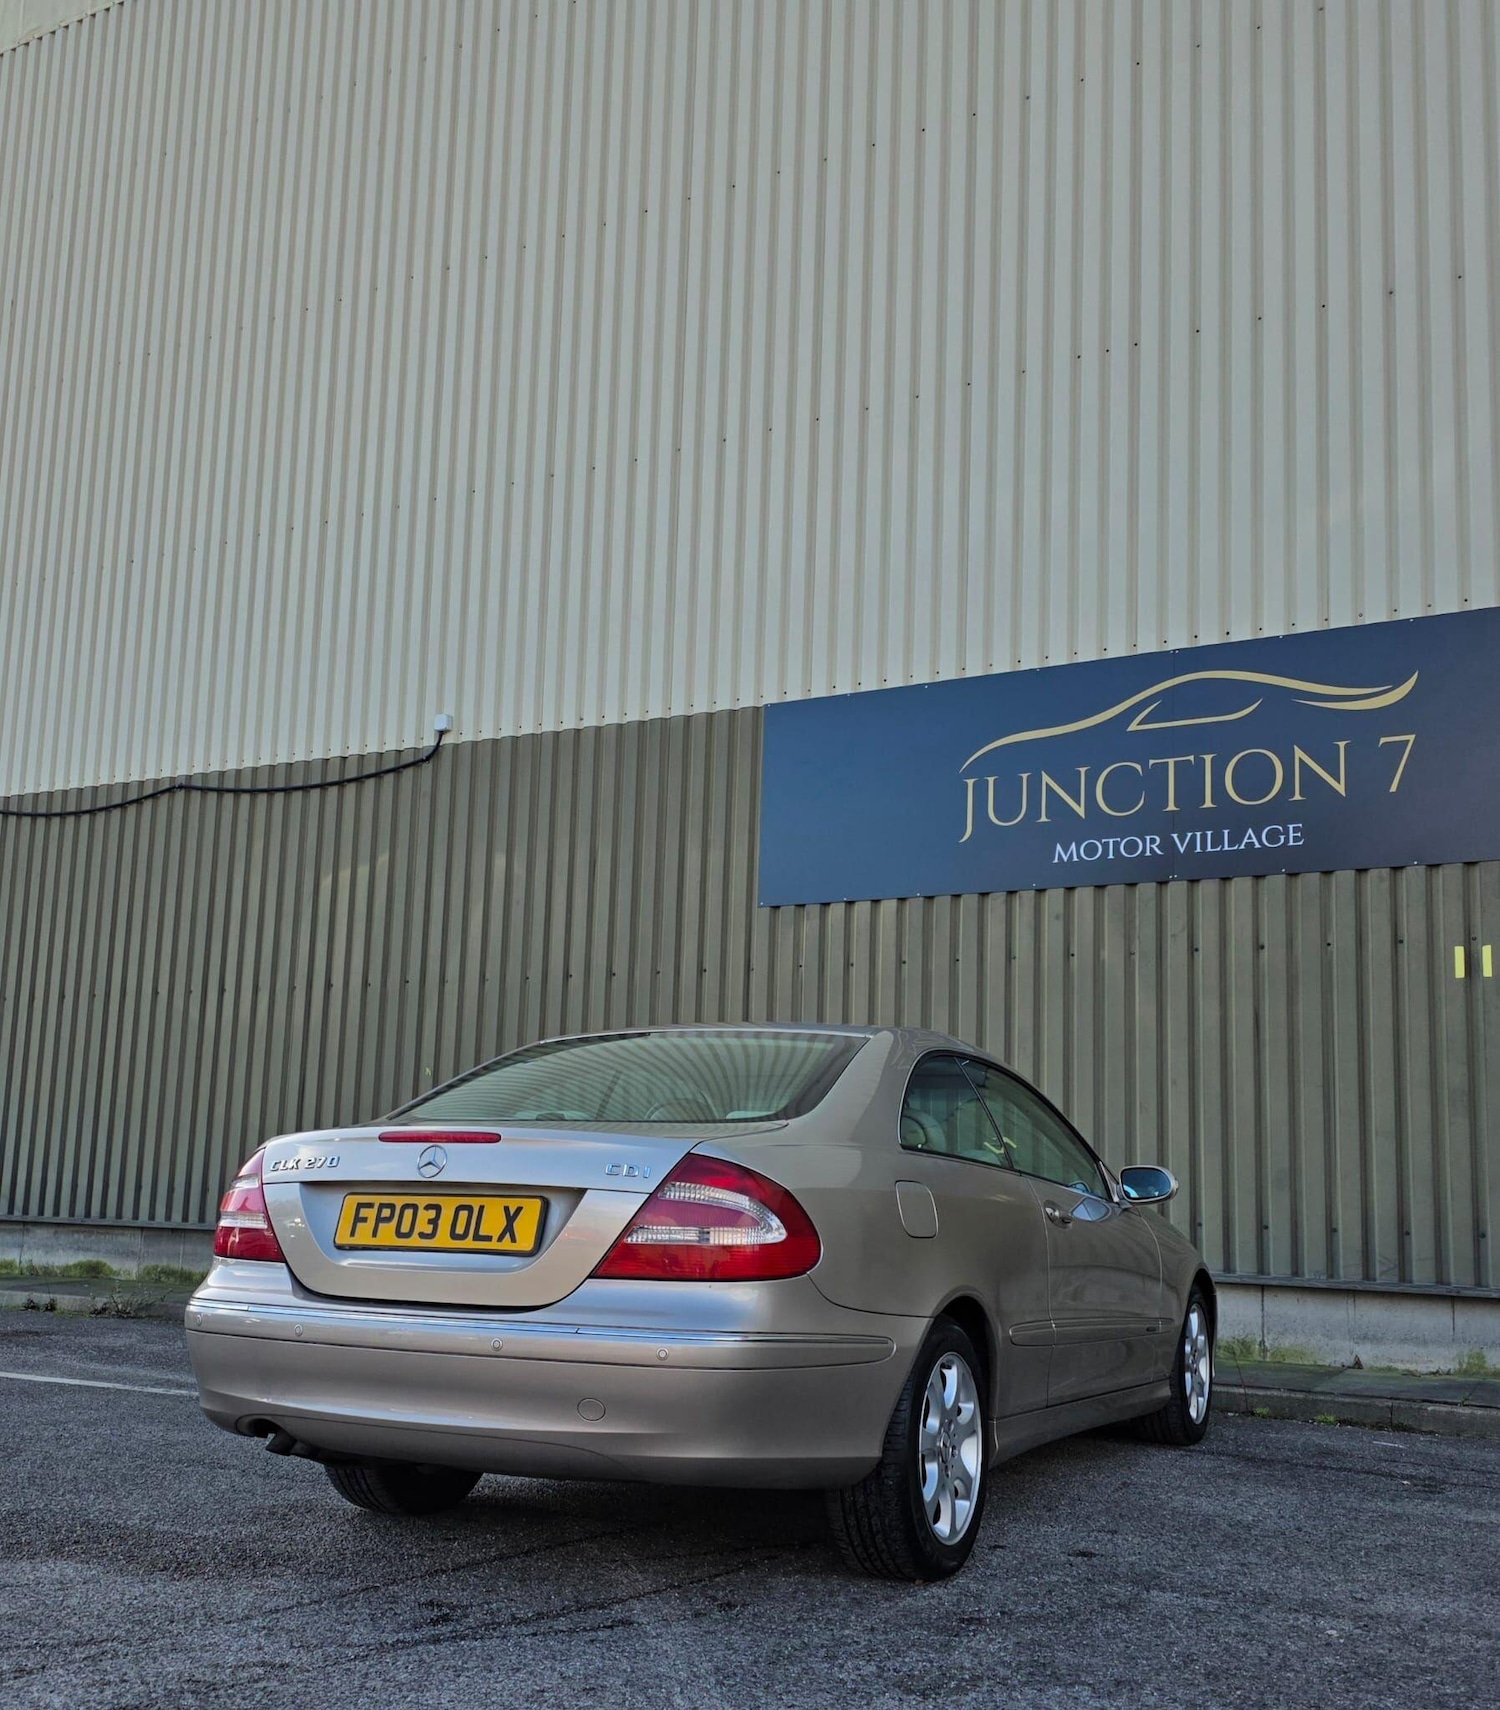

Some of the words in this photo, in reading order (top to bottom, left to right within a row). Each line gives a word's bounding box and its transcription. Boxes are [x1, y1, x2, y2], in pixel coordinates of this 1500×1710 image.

[959, 740, 1351, 843] JUNCTION
[1378, 734, 1416, 793] 7
[1052, 834, 1164, 864] MOTOR
[1171, 824, 1305, 854] VILLAGE
[270, 1157, 301, 1172] CLK
[304, 1155, 340, 1170] 270
[604, 1163, 652, 1179] CDI
[349, 1202, 442, 1240] FP03
[449, 1204, 524, 1244] OLX
